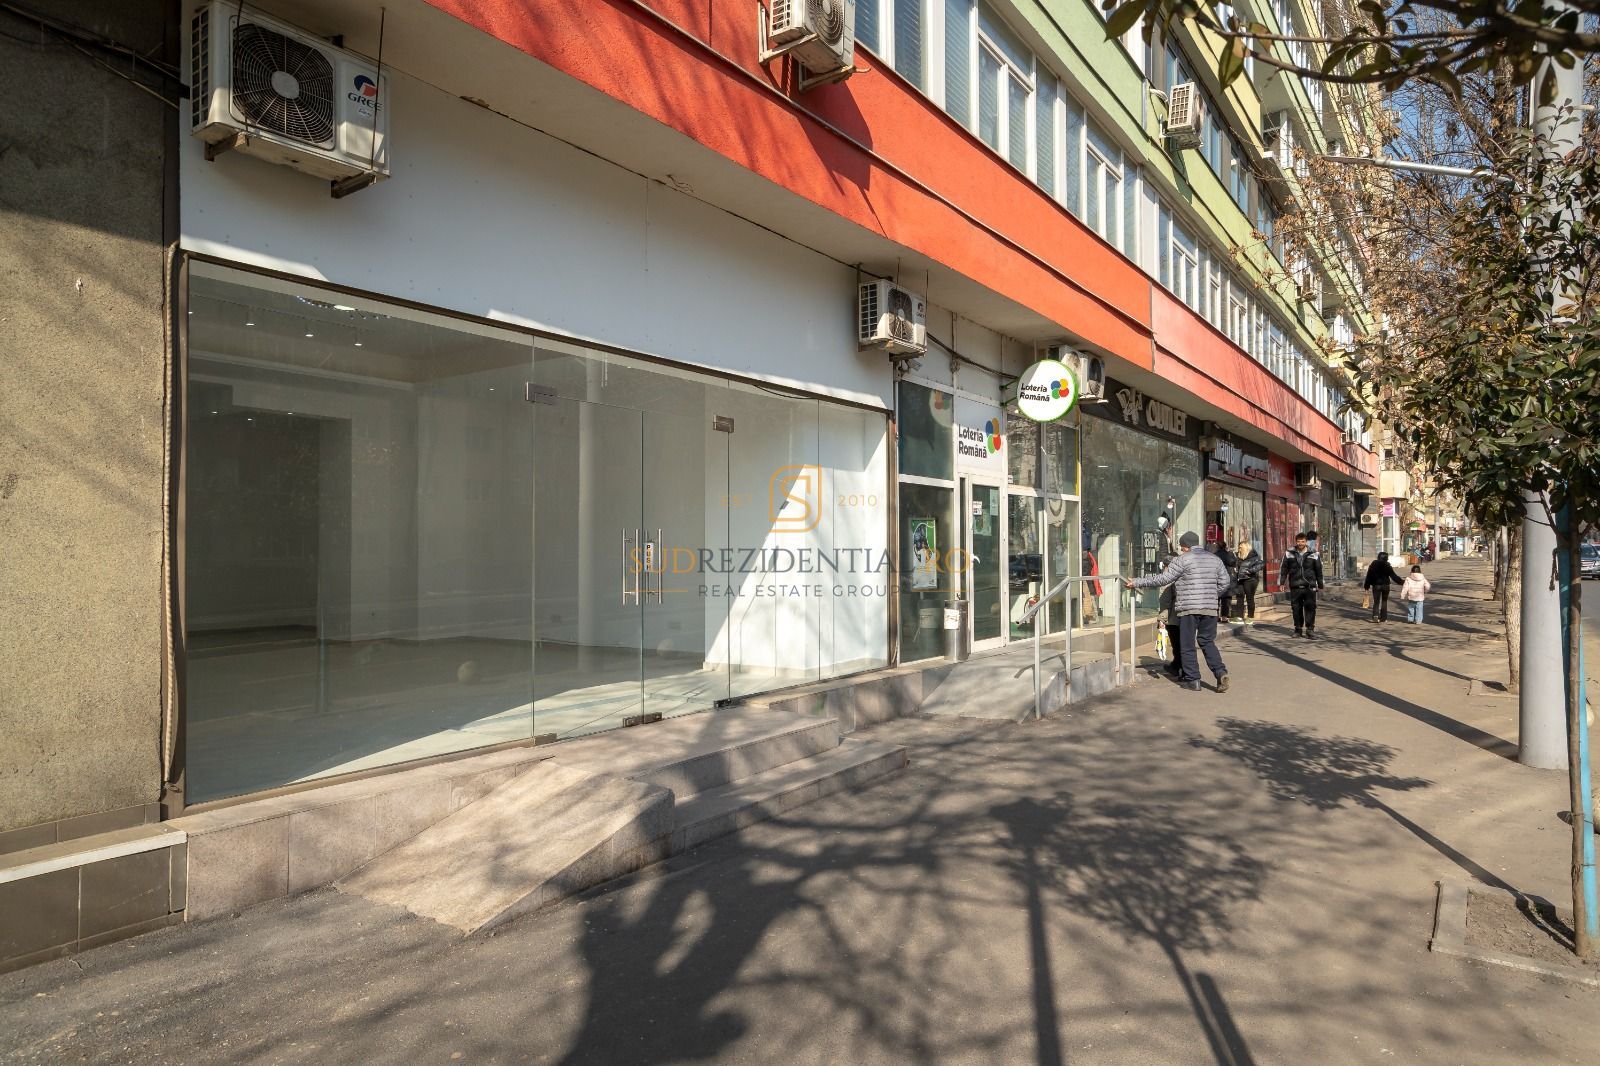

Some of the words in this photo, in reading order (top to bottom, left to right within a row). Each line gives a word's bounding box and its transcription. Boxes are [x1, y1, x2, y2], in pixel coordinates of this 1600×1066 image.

[348, 92, 383, 111] GREE
[1020, 391, 1050, 402] Română
[1021, 383, 1048, 393] Loteria
[1146, 399, 1187, 437] OUTLET
[958, 423, 984, 443] Loteria
[958, 441, 988, 459] Română
